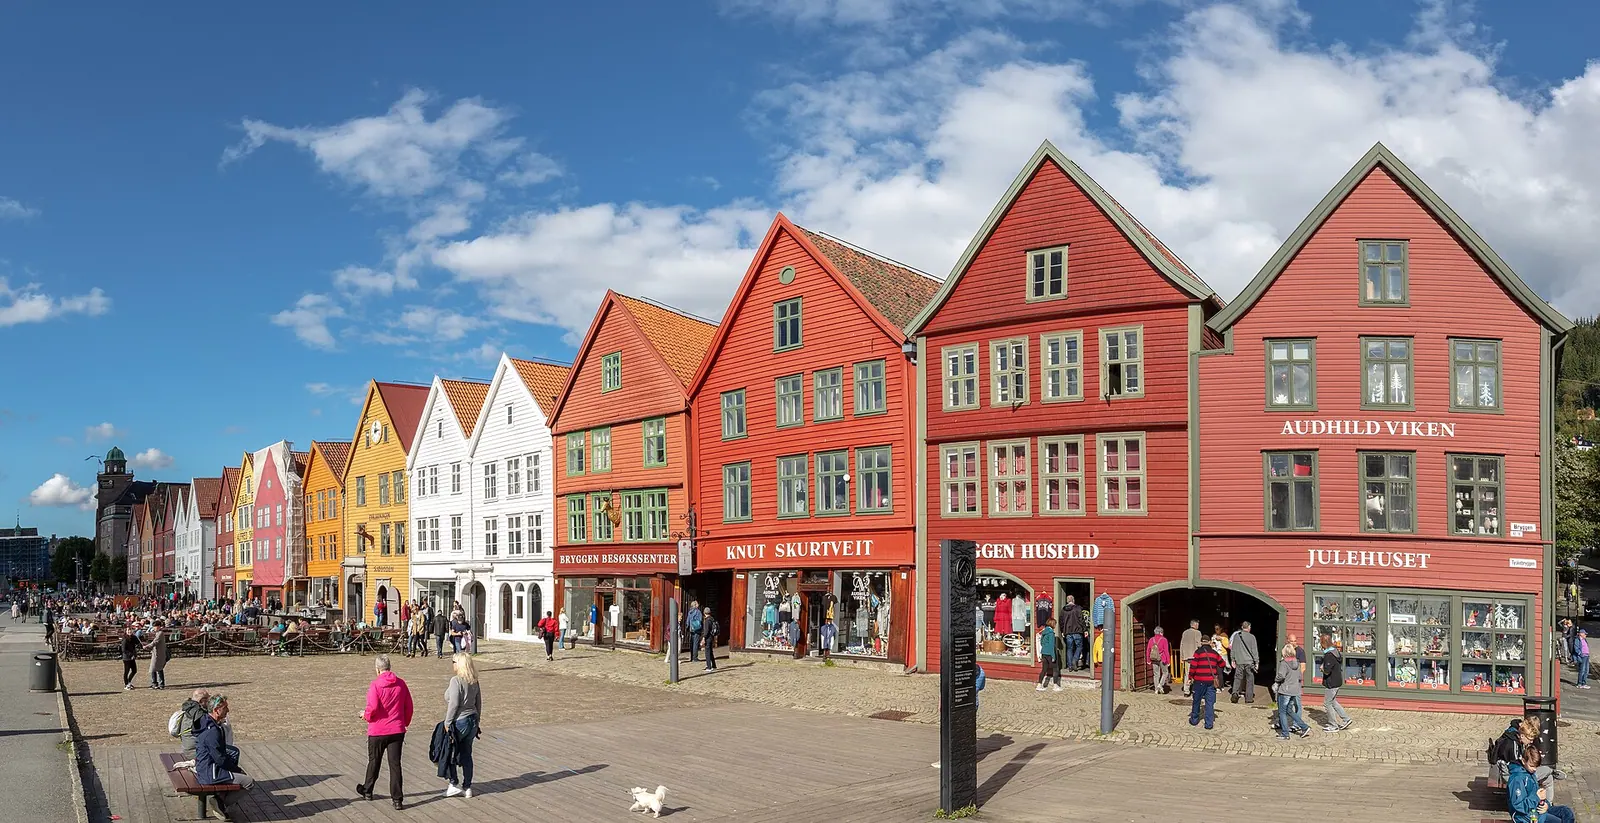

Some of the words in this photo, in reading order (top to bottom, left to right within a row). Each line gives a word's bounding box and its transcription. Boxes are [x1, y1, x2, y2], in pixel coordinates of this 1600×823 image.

[1281, 420, 1381, 435] AUDHILD
[1384, 421, 1456, 437] VIKEN
[560, 554, 599, 564] BRYGGEN
[602, 553, 677, 564] BESØKSSENTER
[726, 544, 766, 560] KNUT
[775, 540, 873, 557] SKURTVEIT
[1021, 543, 1100, 559] HUSFLID
[1306, 549, 1431, 568] JULEHUSET
